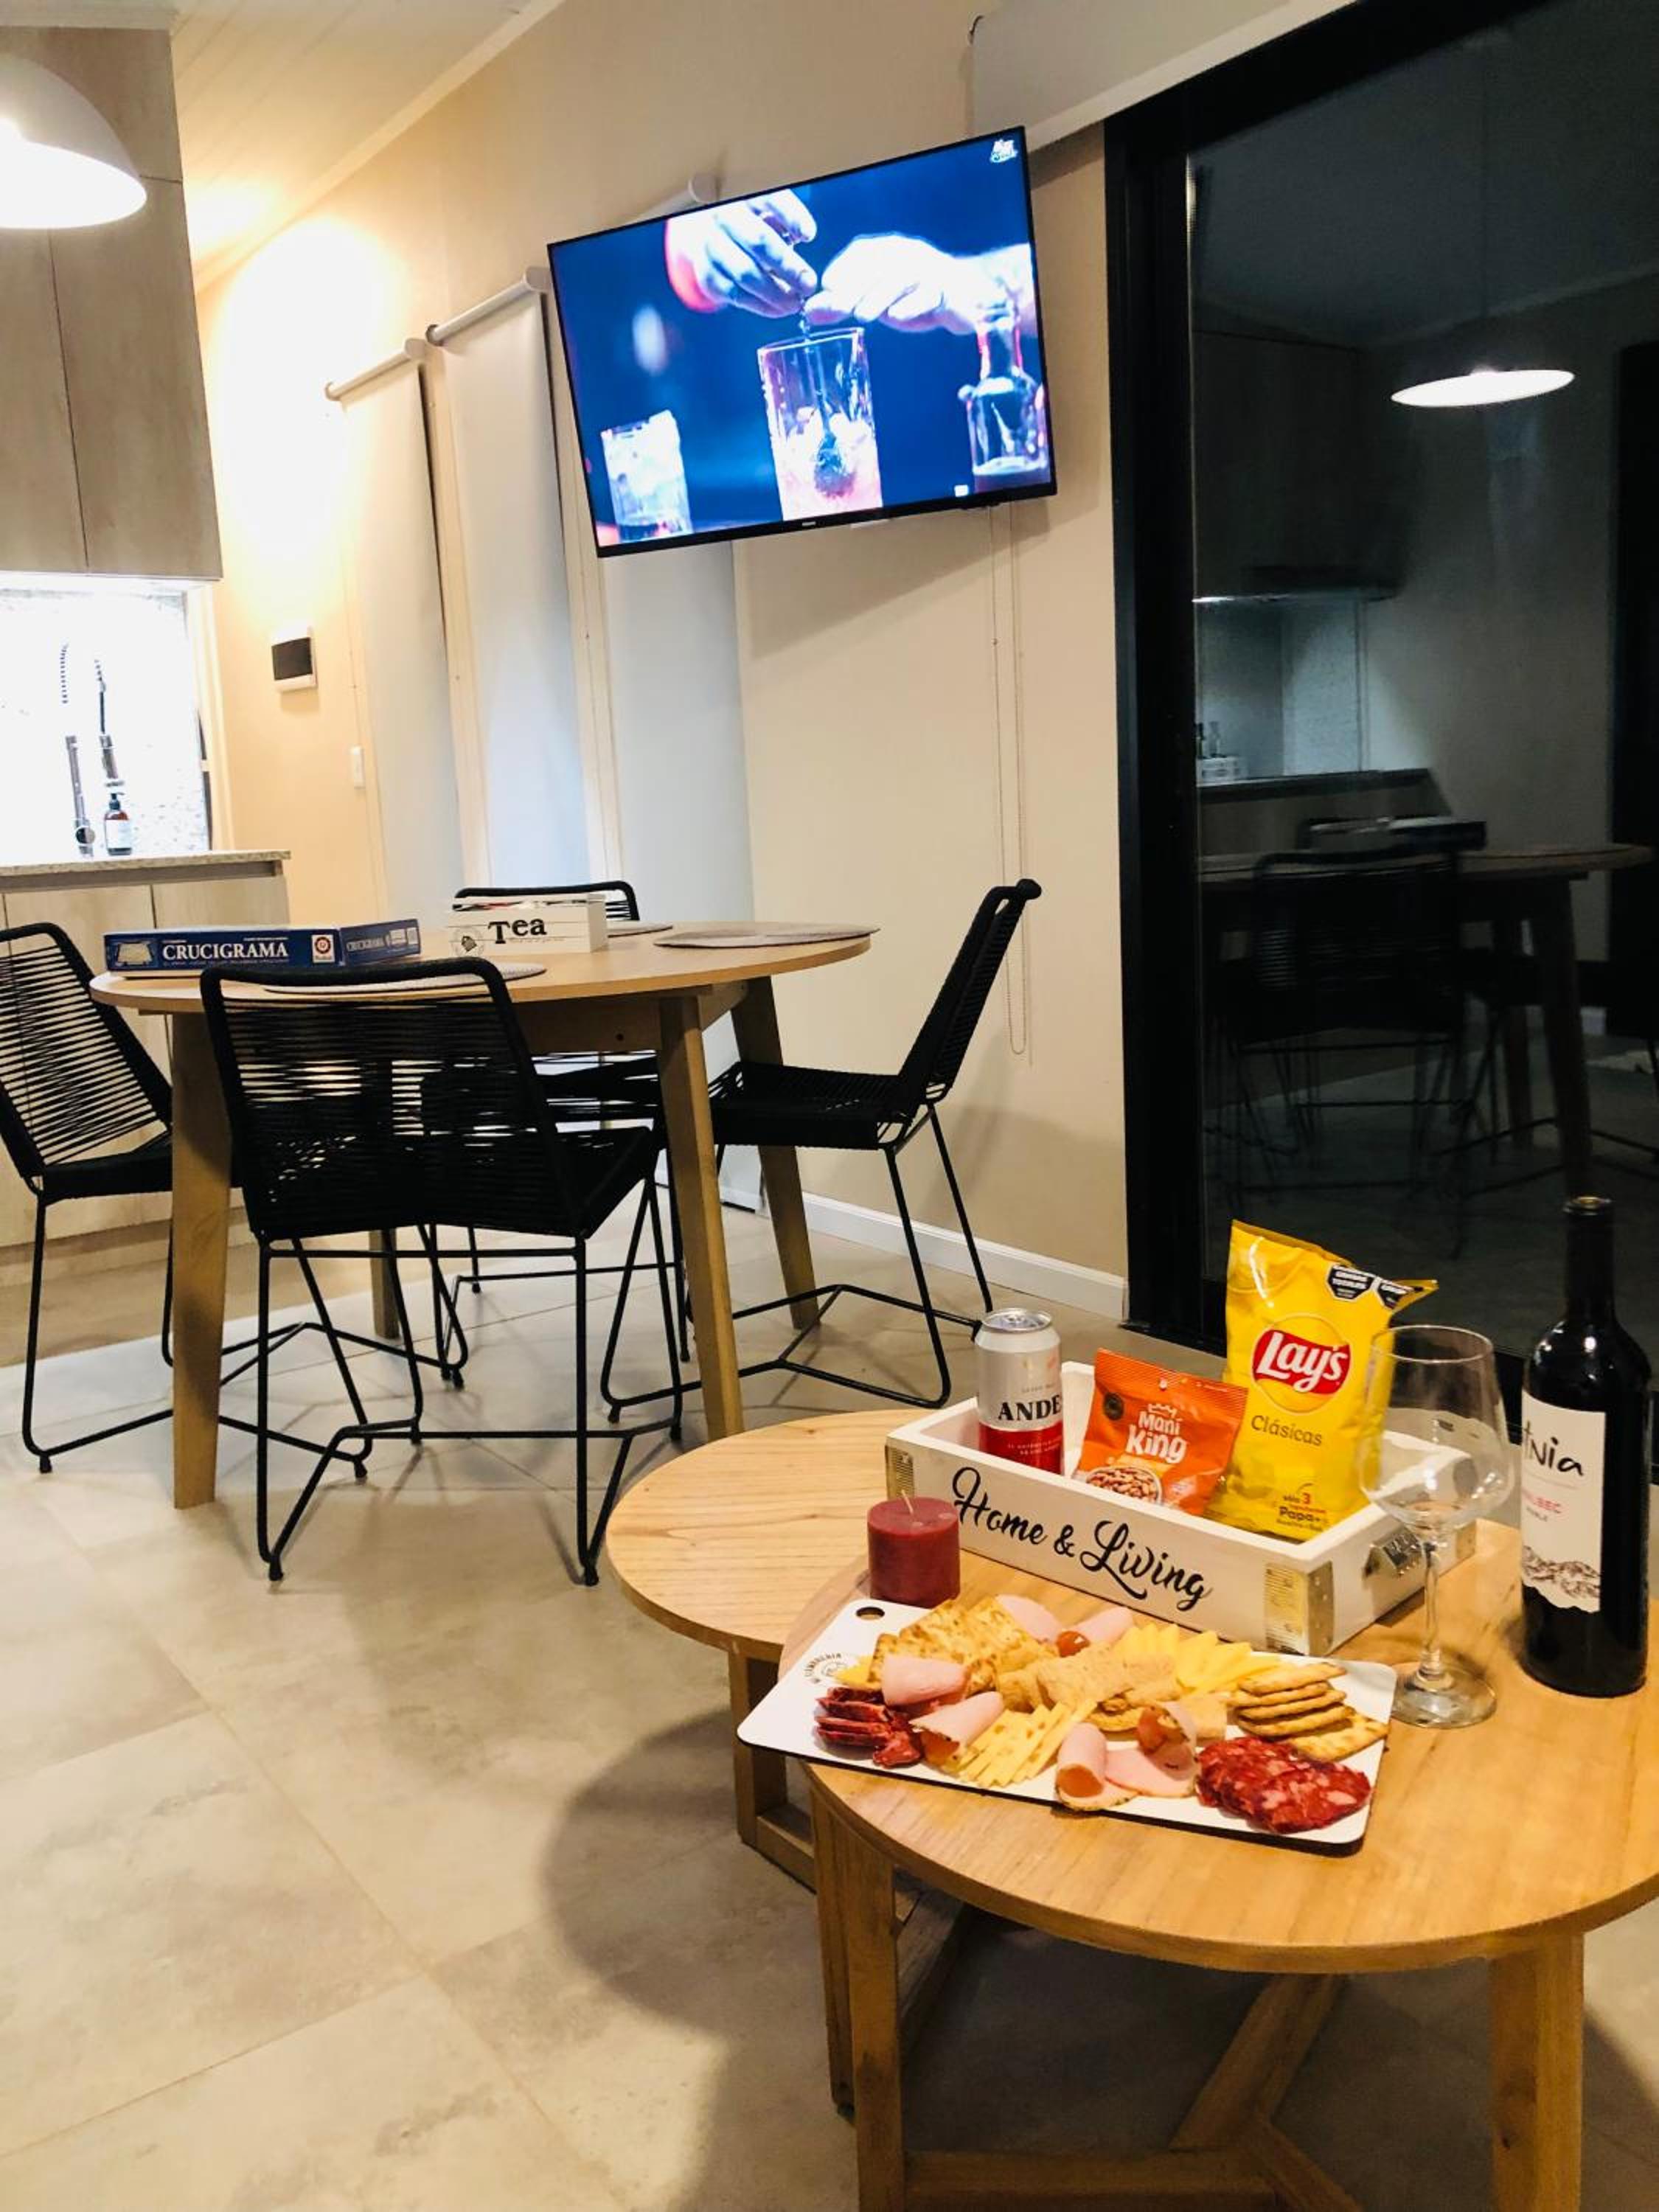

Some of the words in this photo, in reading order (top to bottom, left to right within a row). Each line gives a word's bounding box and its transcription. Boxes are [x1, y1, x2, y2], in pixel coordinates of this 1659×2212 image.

[488, 918, 547, 945] Tea
[163, 943, 288, 960] CRUCIGRAMA
[1255, 1331, 1349, 1393] Lay's
[1251, 1415, 1322, 1447] Clásicas
[1303, 1492, 1310, 1505] 3
[952, 1467, 1048, 1545] Home
[1054, 1524, 1076, 1558] &
[1080, 1520, 1213, 1612] Living
